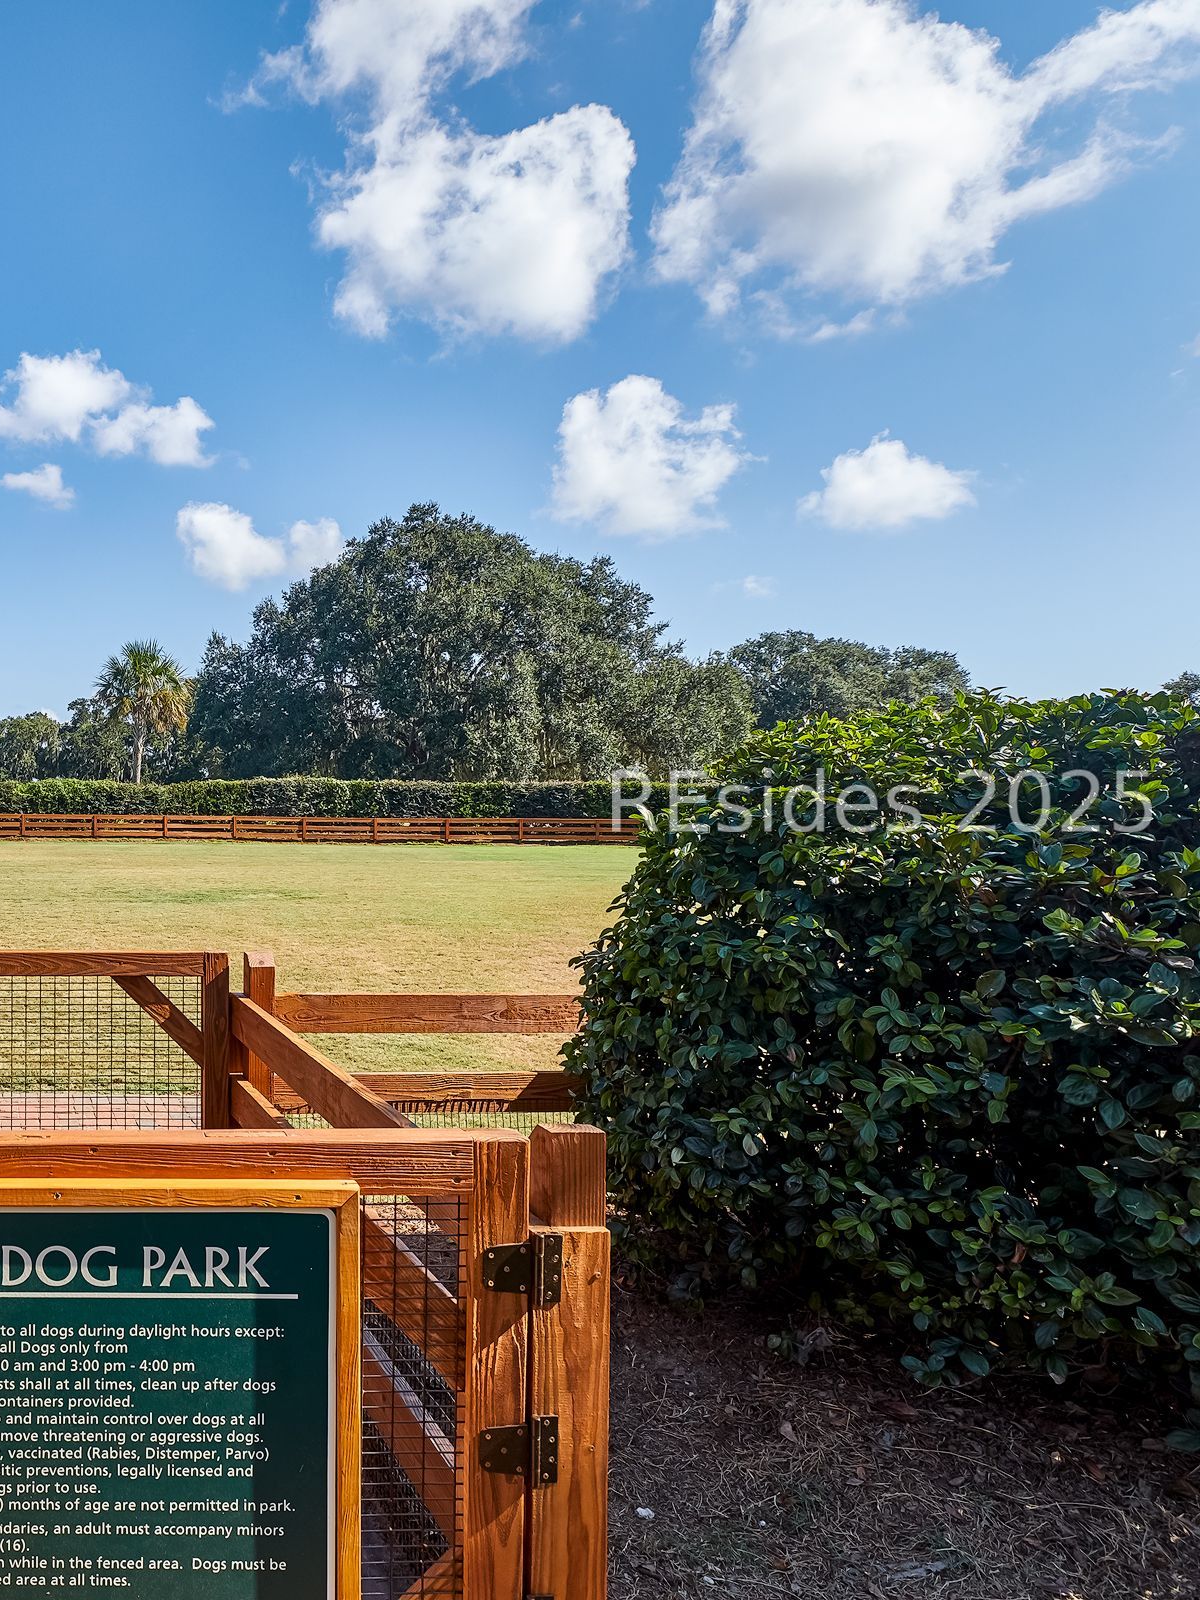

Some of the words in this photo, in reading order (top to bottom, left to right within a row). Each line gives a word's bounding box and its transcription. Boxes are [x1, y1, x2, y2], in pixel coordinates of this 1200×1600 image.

[1, 1245, 118, 1288] DOG
[142, 1246, 270, 1288] PARK
[0, 1325, 16, 1337] to
[19, 1323, 36, 1337] all
[40, 1323, 75, 1340] dogs
[78, 1323, 125, 1340] during
[129, 1323, 187, 1340] daylight
[191, 1323, 231, 1338] hours
[234, 1326, 286, 1341] except:
[20, 1341, 56, 1357] Dogs
[59, 1340, 91, 1357] only
[93, 1340, 128, 1354] from
[13, 1361, 35, 1372] am
[39, 1358, 66, 1372] and
[70, 1359, 100, 1372] 3:00
[103, 1362, 126, 1375] pm
[138, 1359, 169, 1372] 4:00
[172, 1362, 195, 1375] pm
[19, 1377, 51, 1391] shall
[55, 1378, 70, 1391] at
[73, 1377, 90, 1391] all
[94, 1377, 136, 1393] times,
[140, 1377, 177, 1391] clean
[181, 1380, 200, 1394] up
[204, 1377, 239, 1391] after
[242, 1377, 276, 1395] dogs
[68, 1394, 135, 1411] provided.
[5, 1411, 32, 1425] and
[36, 1411, 99, 1425] maintain
[102, 1411, 153, 1425] control
[157, 1415, 189, 1425] over
[192, 1412, 226, 1429] dogs
[230, 1414, 245, 1426] at
[248, 1412, 265, 1426] all
[42, 1428, 126, 1446] threatening
[130, 1432, 146, 1443] or
[149, 1429, 223, 1447] aggressive
[226, 1429, 264, 1446] dogs.
[7, 1446, 83, 1460] vaccinated
[86, 1446, 141, 1462] (Rabies,
[145, 1446, 221, 1463] Distemper,
[225, 1447, 270, 1462] Parvo)
[26, 1463, 112, 1479] preventions,
[117, 1463, 163, 1480] legally
[167, 1463, 223, 1477] licensed
[226, 1464, 254, 1478] and
[16, 1480, 51, 1497] prior
[54, 1481, 70, 1494] to
[74, 1483, 101, 1494] use.
[8, 1497, 61, 1511] months
[64, 1497, 81, 1511] of
[83, 1501, 110, 1514] age
[113, 1501, 137, 1512] are
[140, 1499, 165, 1512] not
[169, 1498, 239, 1515] permitted
[243, 1498, 257, 1512] in
[259, 1499, 296, 1515] park.
[53, 1524, 71, 1535] an
[74, 1521, 112, 1535] adult
[115, 1523, 151, 1536] must
[153, 1525, 233, 1539] accompany
[236, 1522, 285, 1537] minors
[0, 1538, 30, 1554] (16).
[8, 1555, 48, 1569] while
[51, 1555, 65, 1569] in
[68, 1555, 93, 1570] the
[96, 1555, 144, 1570] fenced
[148, 1559, 184, 1570] area.
[191, 1557, 227, 1574] Dogs
[230, 1559, 266, 1571] must
[269, 1557, 287, 1571] be
[15, 1575, 46, 1586] area
[50, 1574, 65, 1587] at
[68, 1572, 85, 1586] all
[89, 1573, 131, 1587] times.
